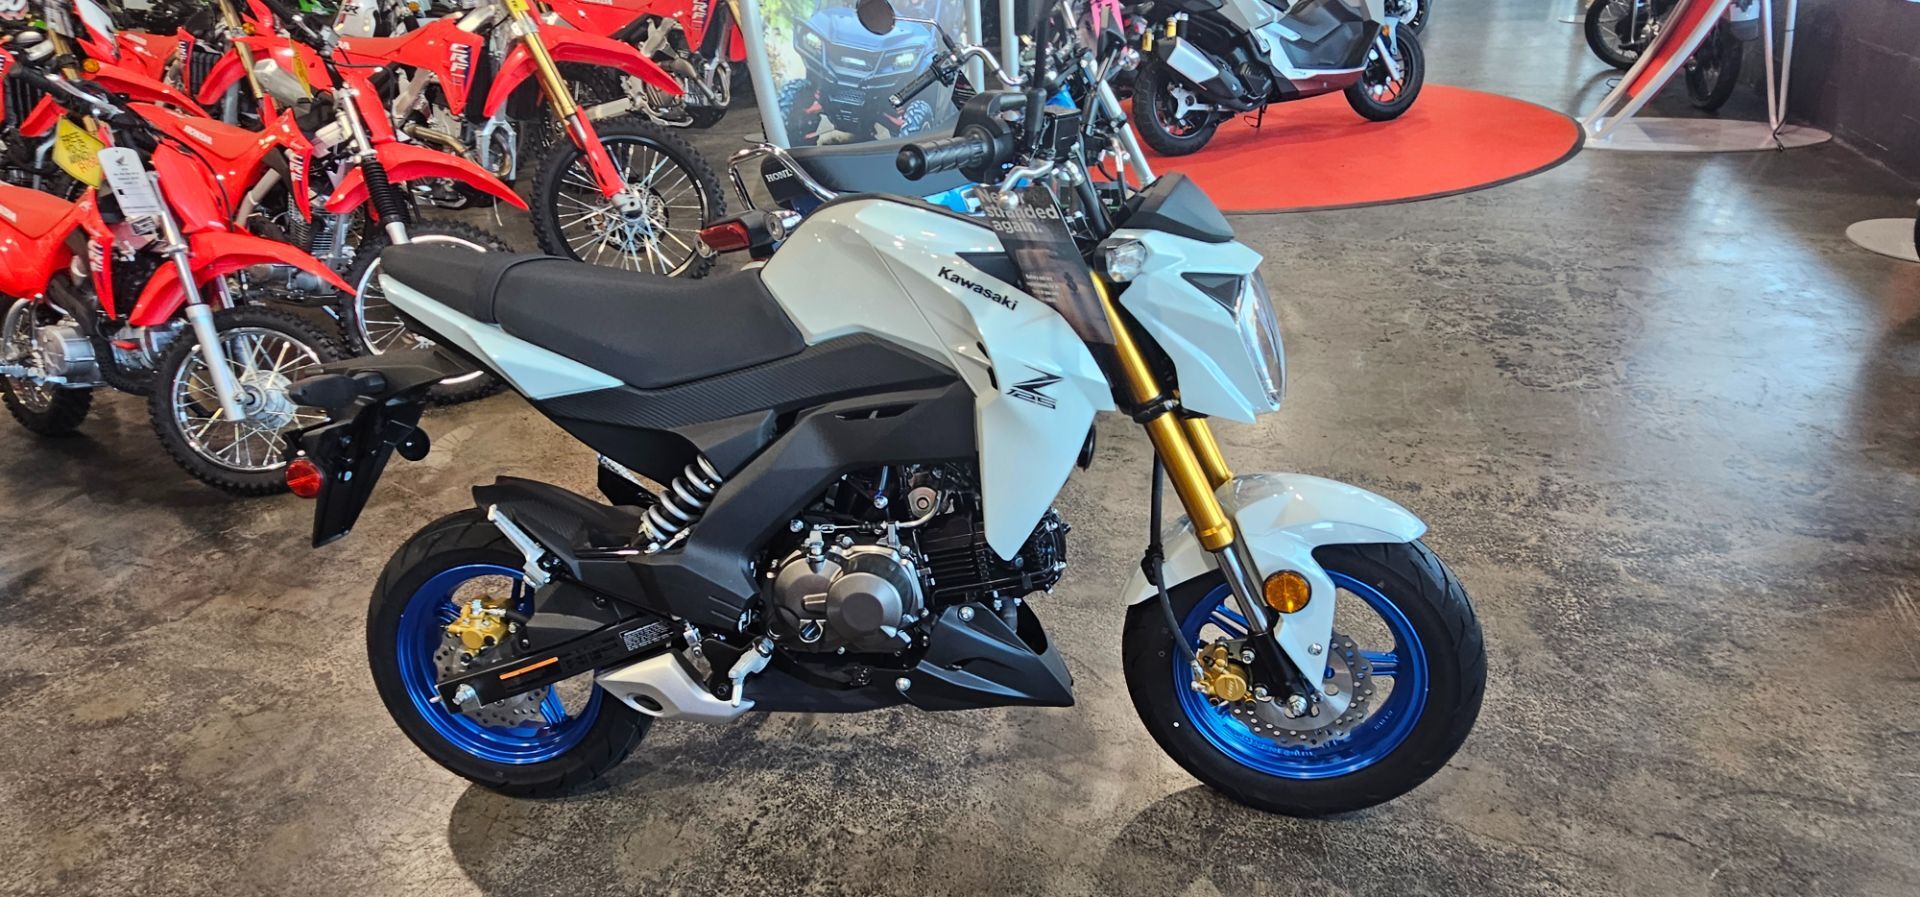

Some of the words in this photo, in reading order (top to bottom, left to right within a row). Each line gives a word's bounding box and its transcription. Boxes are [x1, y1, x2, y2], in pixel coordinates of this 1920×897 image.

[981, 188, 1025, 204] Ner
[985, 204, 1060, 219] stranded
[992, 219, 1043, 234] again.
[937, 266, 1018, 311] Kawasaki
[1005, 388, 1058, 410] 125
